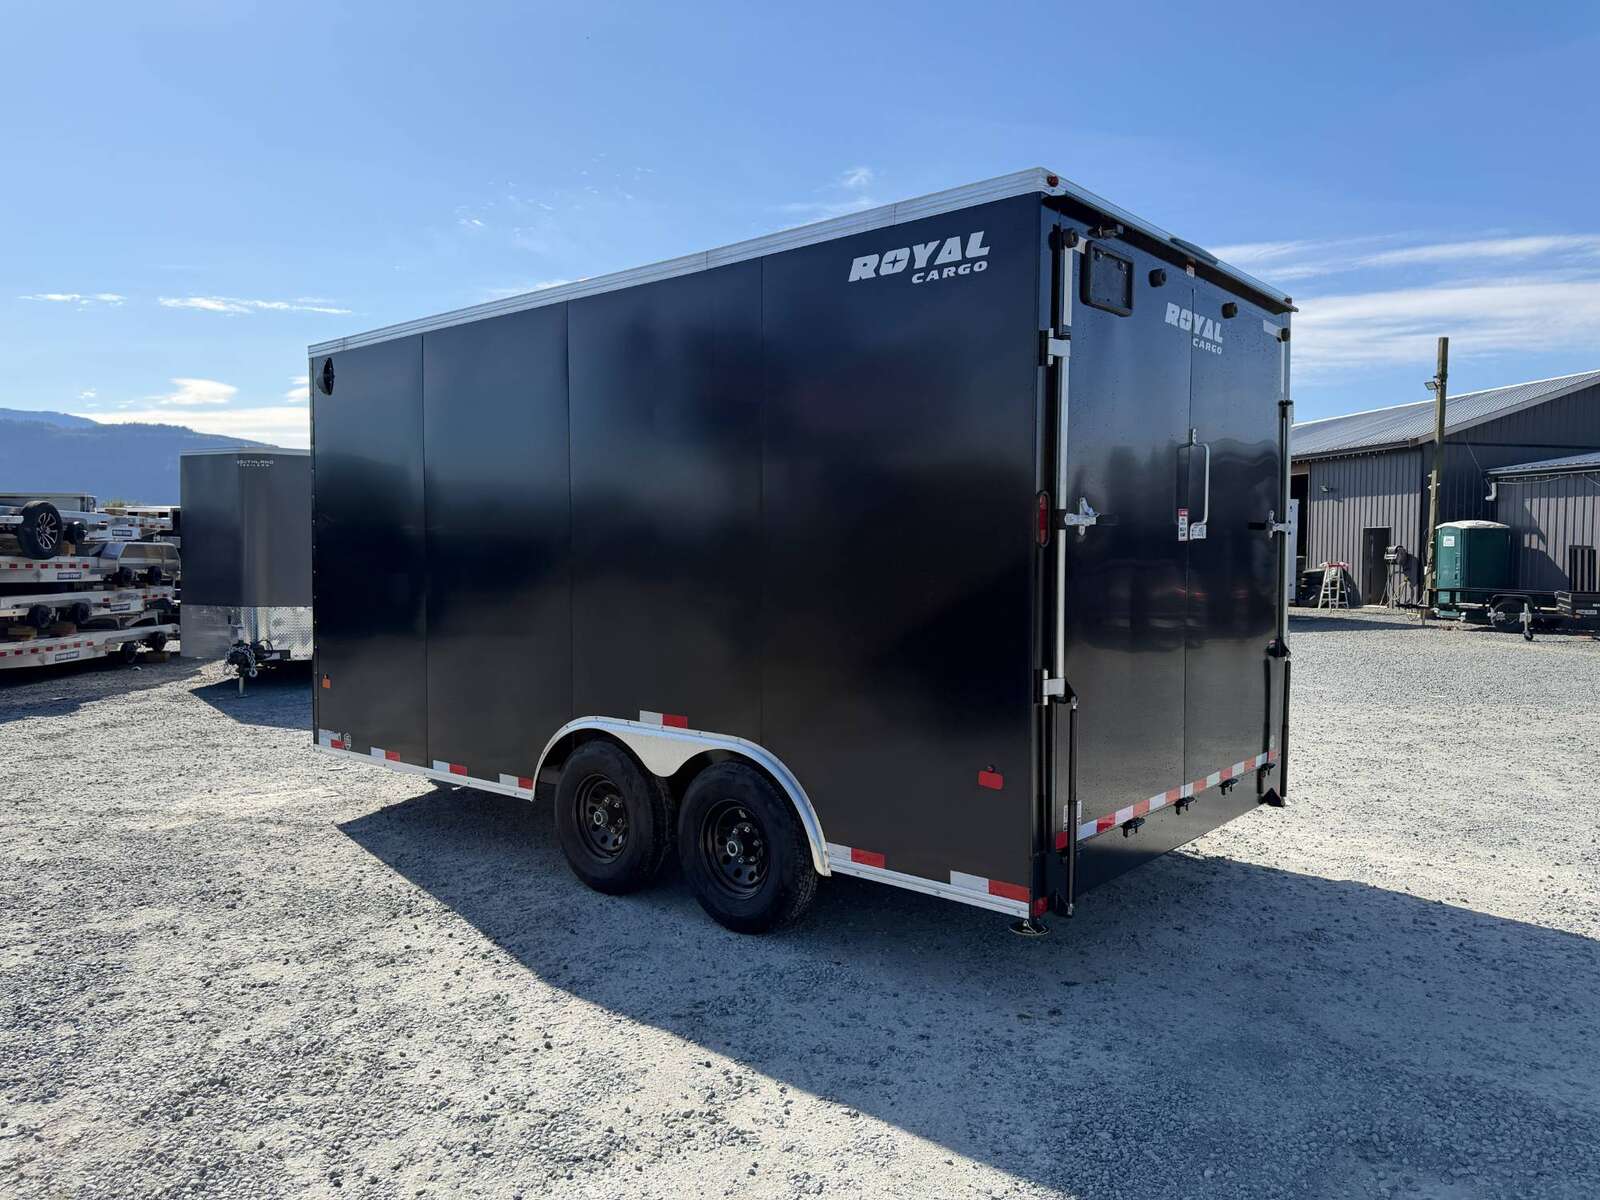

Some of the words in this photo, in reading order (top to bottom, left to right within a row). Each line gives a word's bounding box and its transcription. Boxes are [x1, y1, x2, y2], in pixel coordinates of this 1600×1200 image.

[848, 231, 990, 282] ROYAL
[912, 260, 988, 284] CARGO
[1165, 302, 1223, 344] ROYAL
[1192, 338, 1222, 355] CARGO
